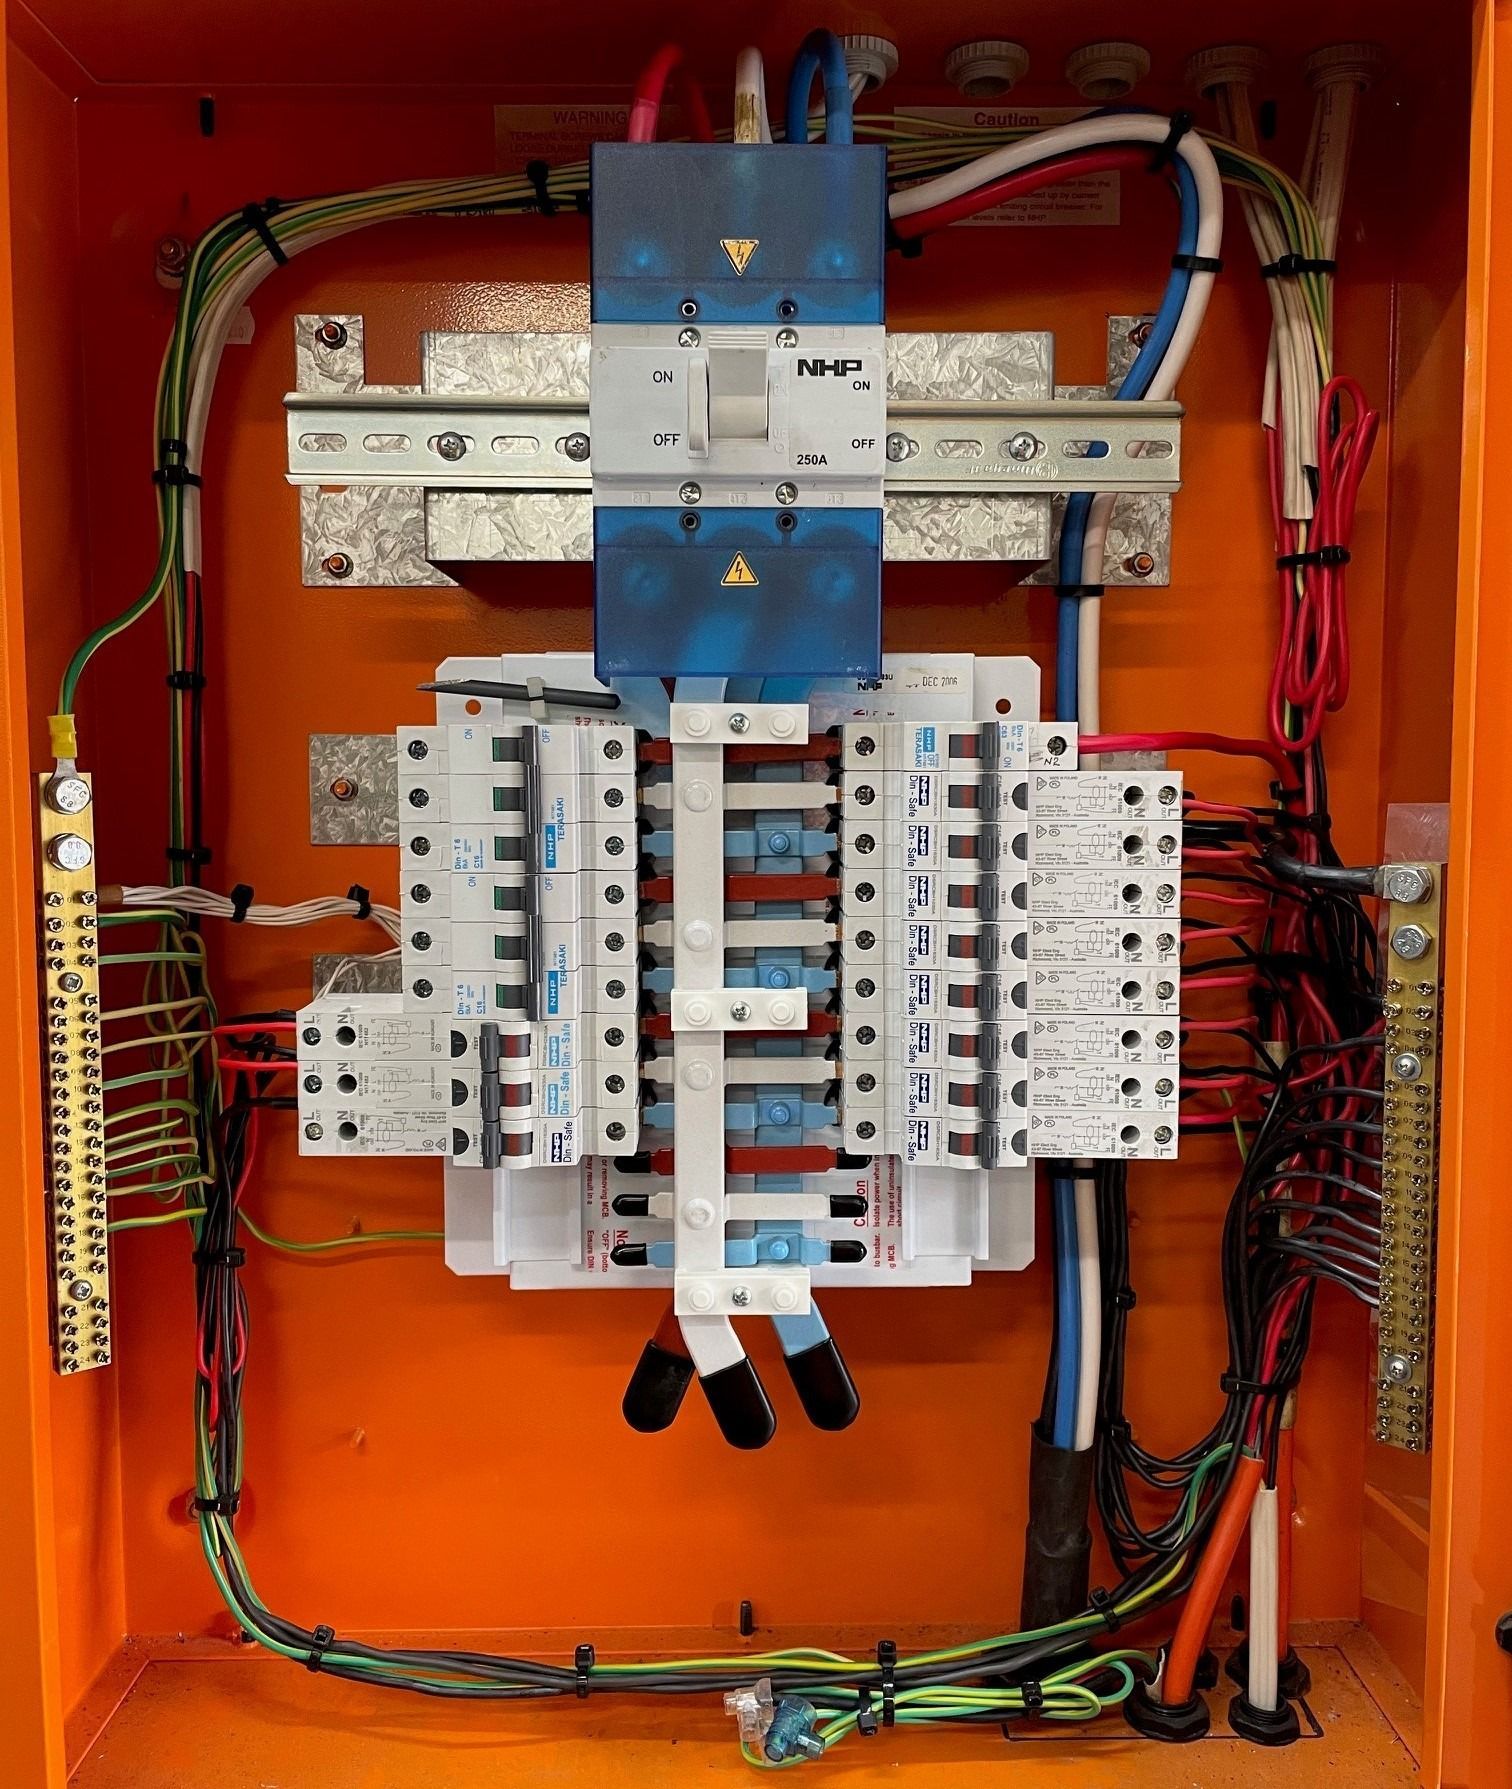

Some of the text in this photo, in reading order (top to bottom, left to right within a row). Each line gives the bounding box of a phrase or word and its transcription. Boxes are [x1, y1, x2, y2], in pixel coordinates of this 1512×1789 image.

[553, 111, 627, 124] WARNING
[974, 112, 1040, 126] Caution
[797, 359, 863, 377] NHP
[652, 371, 673, 384] ON
[852, 381, 871, 391] ON
[653, 434, 681, 446] OFF
[851, 439, 876, 449] OFF
[796, 454, 828, 466] 250A
[922, 676, 938, 687] DEC
[465, 728, 473, 740] ON
[542, 729, 551, 743] OFF
[927, 754, 935, 767] OFF
[1004, 757, 1012, 768] ON
[1044, 757, 1061, 767] N2
[909, 776, 918, 789] Din
[920, 776, 930, 806] NHP
[908, 797, 918, 817] Safe
[1134, 809, 1146, 818] N
[1168, 808, 1179, 817] L
[556, 797, 565, 841] TERASAKI
[908, 826, 917, 839] Din
[547, 832, 555, 861] NHP
[919, 826, 929, 856] NHP
[907, 847, 917, 867] Safe
[1133, 856, 1145, 866] N
[1167, 856, 1178, 864] L
[468, 876, 476, 887] ON
[545, 877, 553, 891] OFF
[908, 875, 917, 889] Din
[919, 876, 929, 906] NHP
[908, 897, 917, 917] Safe
[1130, 905, 1141, 914] N
[1163, 905, 1174, 913] L
[909, 925, 918, 938] Din
[919, 926, 929, 955] NHP
[908, 946, 918, 966] Safe
[1131, 953, 1142, 963] N
[1165, 953, 1177, 961] L
[558, 944, 568, 987] TERASAKI
[909, 974, 918, 988] Din
[549, 979, 557, 1007] NHP
[919, 975, 930, 1005] NHP
[908, 996, 918, 1016] Safe
[1131, 1002, 1143, 1012] N
[1166, 1002, 1177, 1011] L
[303, 1016, 315, 1024] L
[337, 1014, 348, 1023] N
[561, 1024, 571, 1044] Safe
[909, 1022, 918, 1036] Din
[919, 1023, 930, 1053] NHP
[549, 1036, 559, 1066] NHP
[908, 1044, 918, 1064] Safe
[1130, 1053, 1142, 1062] N
[1164, 1053, 1175, 1062] L
[562, 1052, 570, 1066] Din
[303, 1064, 315, 1072] L
[337, 1063, 348, 1072] N
[560, 1072, 570, 1092] Safe
[909, 1072, 918, 1087] Din
[919, 1073, 930, 1103] NHP
[548, 1084, 558, 1114] NHP
[908, 1094, 918, 1114] Safe
[1130, 1099, 1142, 1109] N
[1165, 1100, 1176, 1108] L
[560, 1100, 569, 1115] Din
[303, 1112, 315, 1120] L
[337, 1110, 348, 1120] N
[563, 1121, 573, 1141] Safe
[908, 1120, 917, 1135] Din
[918, 1121, 929, 1151] NHP
[552, 1133, 561, 1162] NHP
[908, 1141, 917, 1161] Safe
[1127, 1147, 1138, 1157] N
[1160, 1148, 1172, 1156] L
[563, 1149, 572, 1162] Din
[601, 1159, 608, 1167] or
[873, 1162, 881, 1180] when
[587, 1171, 595, 1191] result
[600, 1168, 608, 1200] removing
[874, 1182, 882, 1203] power
[873, 1204, 881, 1227] Isolate
[601, 1230, 609, 1250] "OFF"
[873, 1233, 881, 1258] busbar.
[587, 1230, 595, 1269] Ensure DIN
